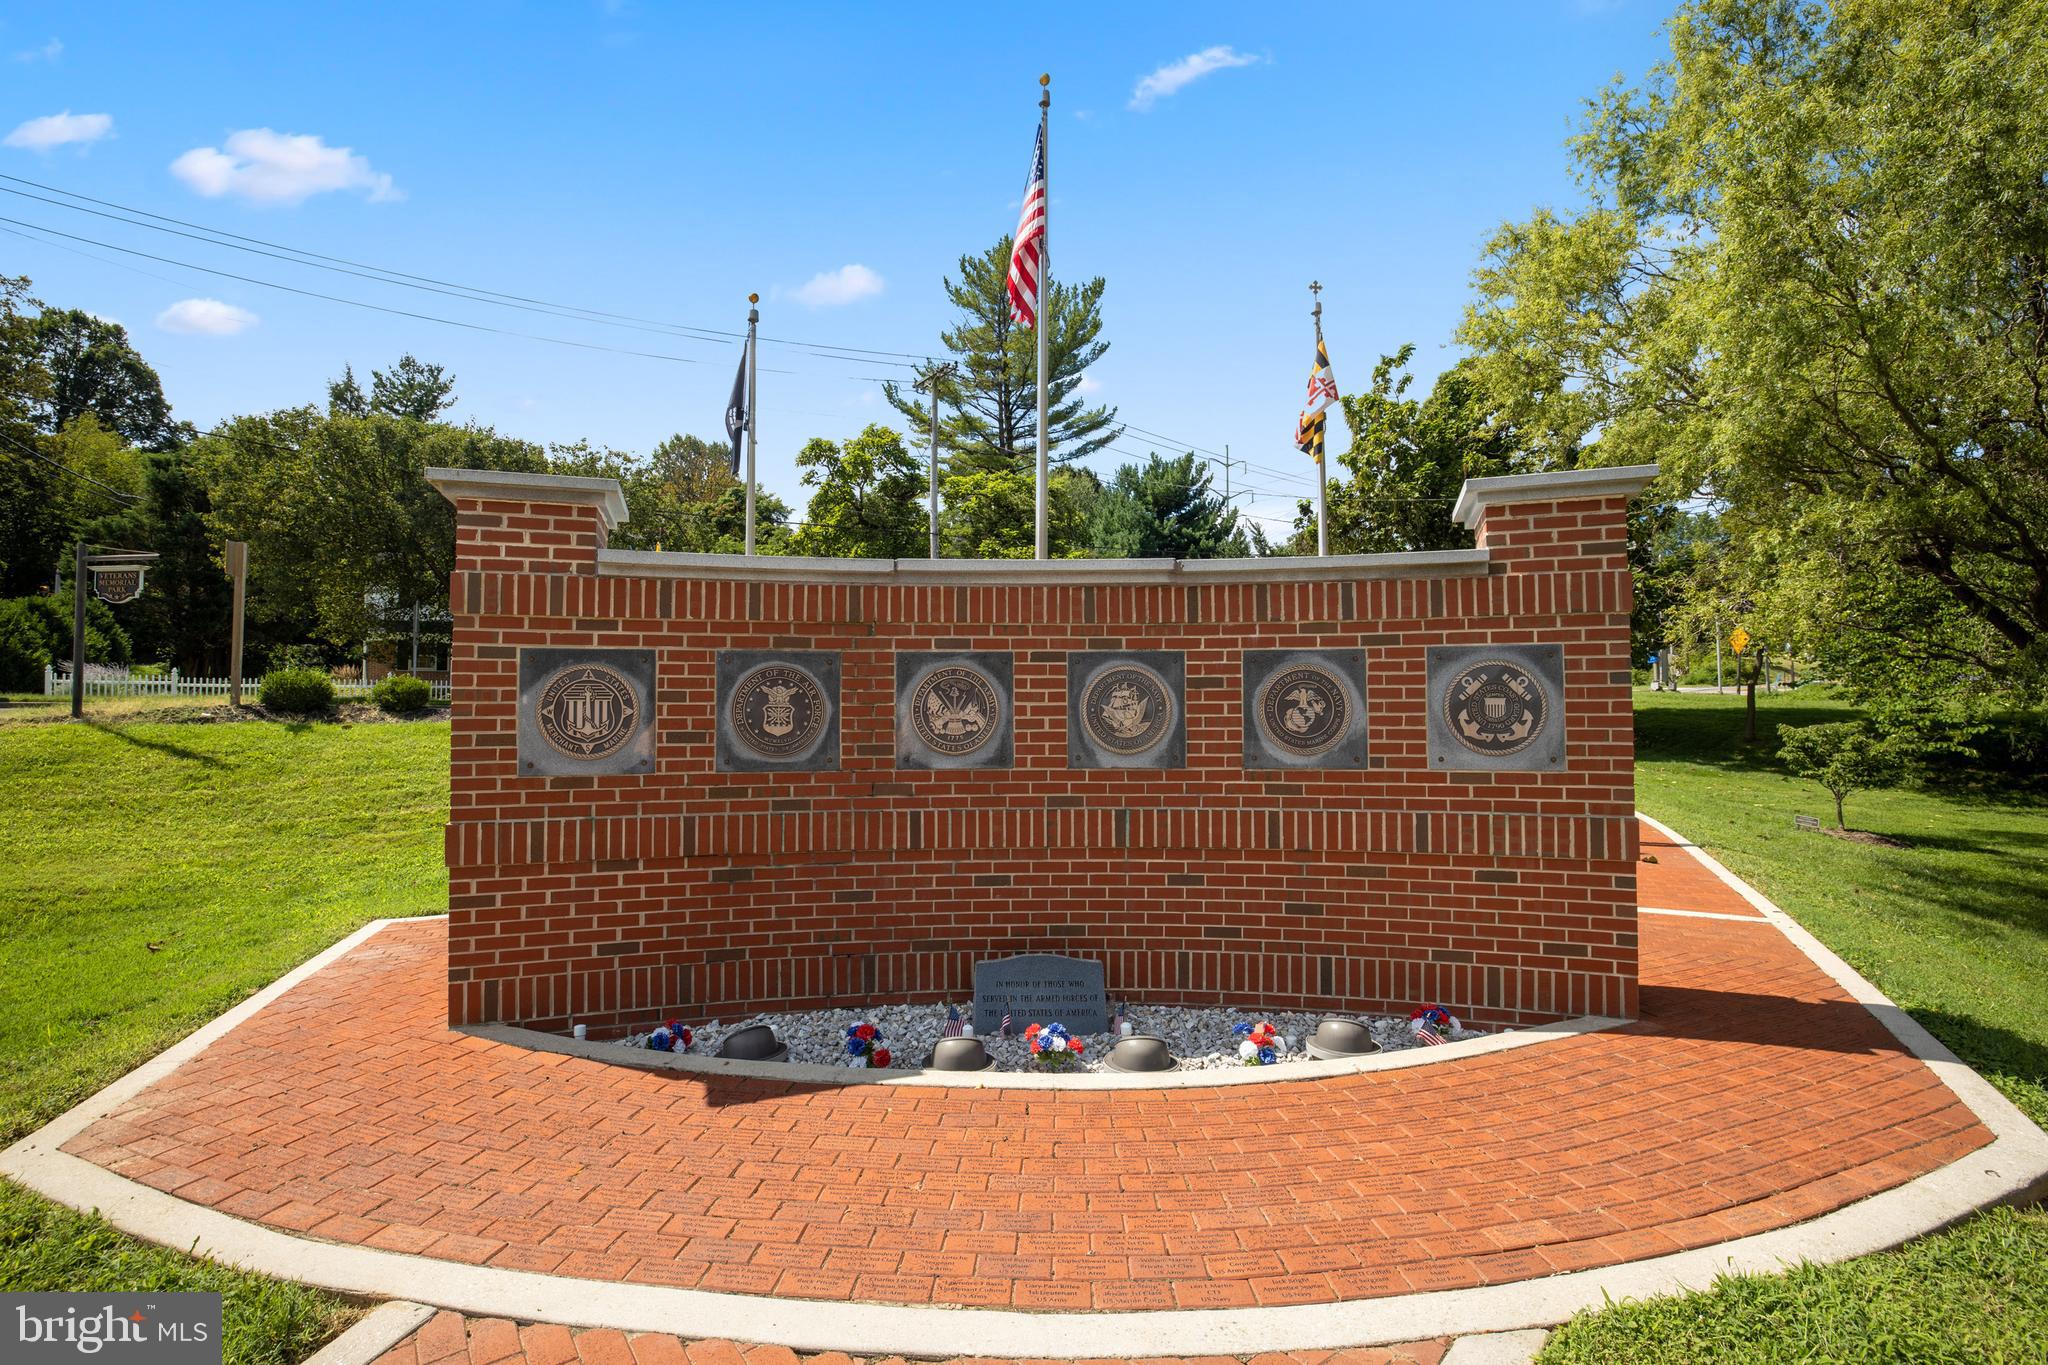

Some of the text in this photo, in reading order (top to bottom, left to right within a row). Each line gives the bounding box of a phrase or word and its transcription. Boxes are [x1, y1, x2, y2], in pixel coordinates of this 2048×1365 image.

[100, 572, 137, 580] VETERANS
[546, 675, 630, 702] UNITED STATES
[735, 669, 822, 729] DEPARTMENT OF THE AIR FORCE
[915, 671, 953, 706] DEPARTMENT
[969, 674, 983, 685] THE
[1091, 673, 1125, 705] DEPARTMENT
[1267, 673, 1310, 712] DEPARTMENT
[1331, 688, 1343, 712] NAVY
[546, 723, 628, 752] MERCHANT MARINE
[914, 714, 932, 741] UNITED
[982, 994, 1099, 1003] SERVED IN THE ARMED FORCES OF
[984, 1009, 998, 1017] THE
[1028, 1009, 1052, 1017] STATES
[1054, 1009, 1063, 1017] OF
[1065, 1009, 1098, 1017] AMERICA
